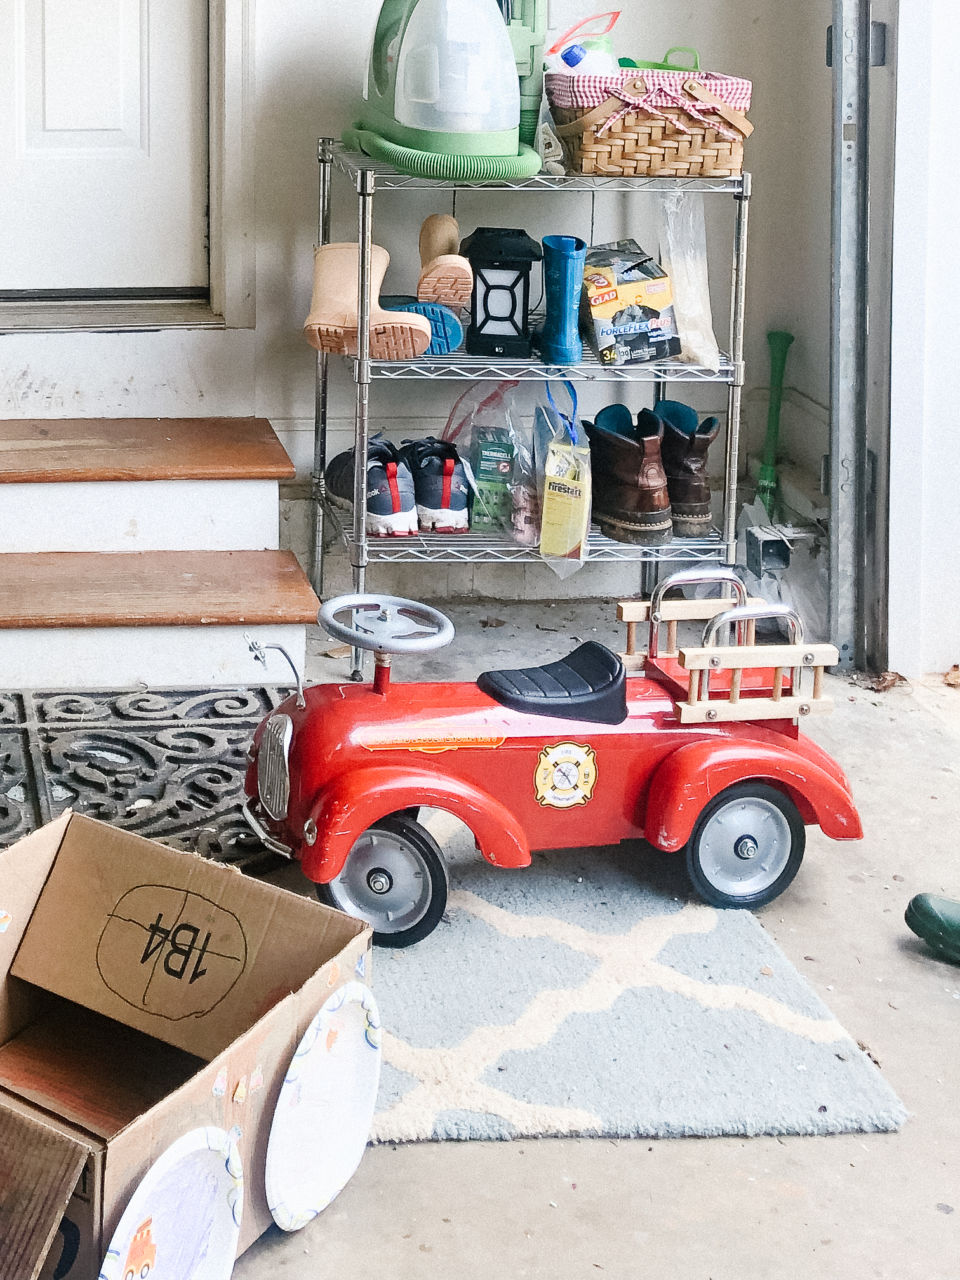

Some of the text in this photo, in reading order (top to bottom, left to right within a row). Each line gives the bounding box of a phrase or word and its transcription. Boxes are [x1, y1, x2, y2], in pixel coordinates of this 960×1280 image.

[591, 291, 617, 306] GLAD
[602, 350, 617, 360] 34
[140, 912, 212, 985] 1B4
